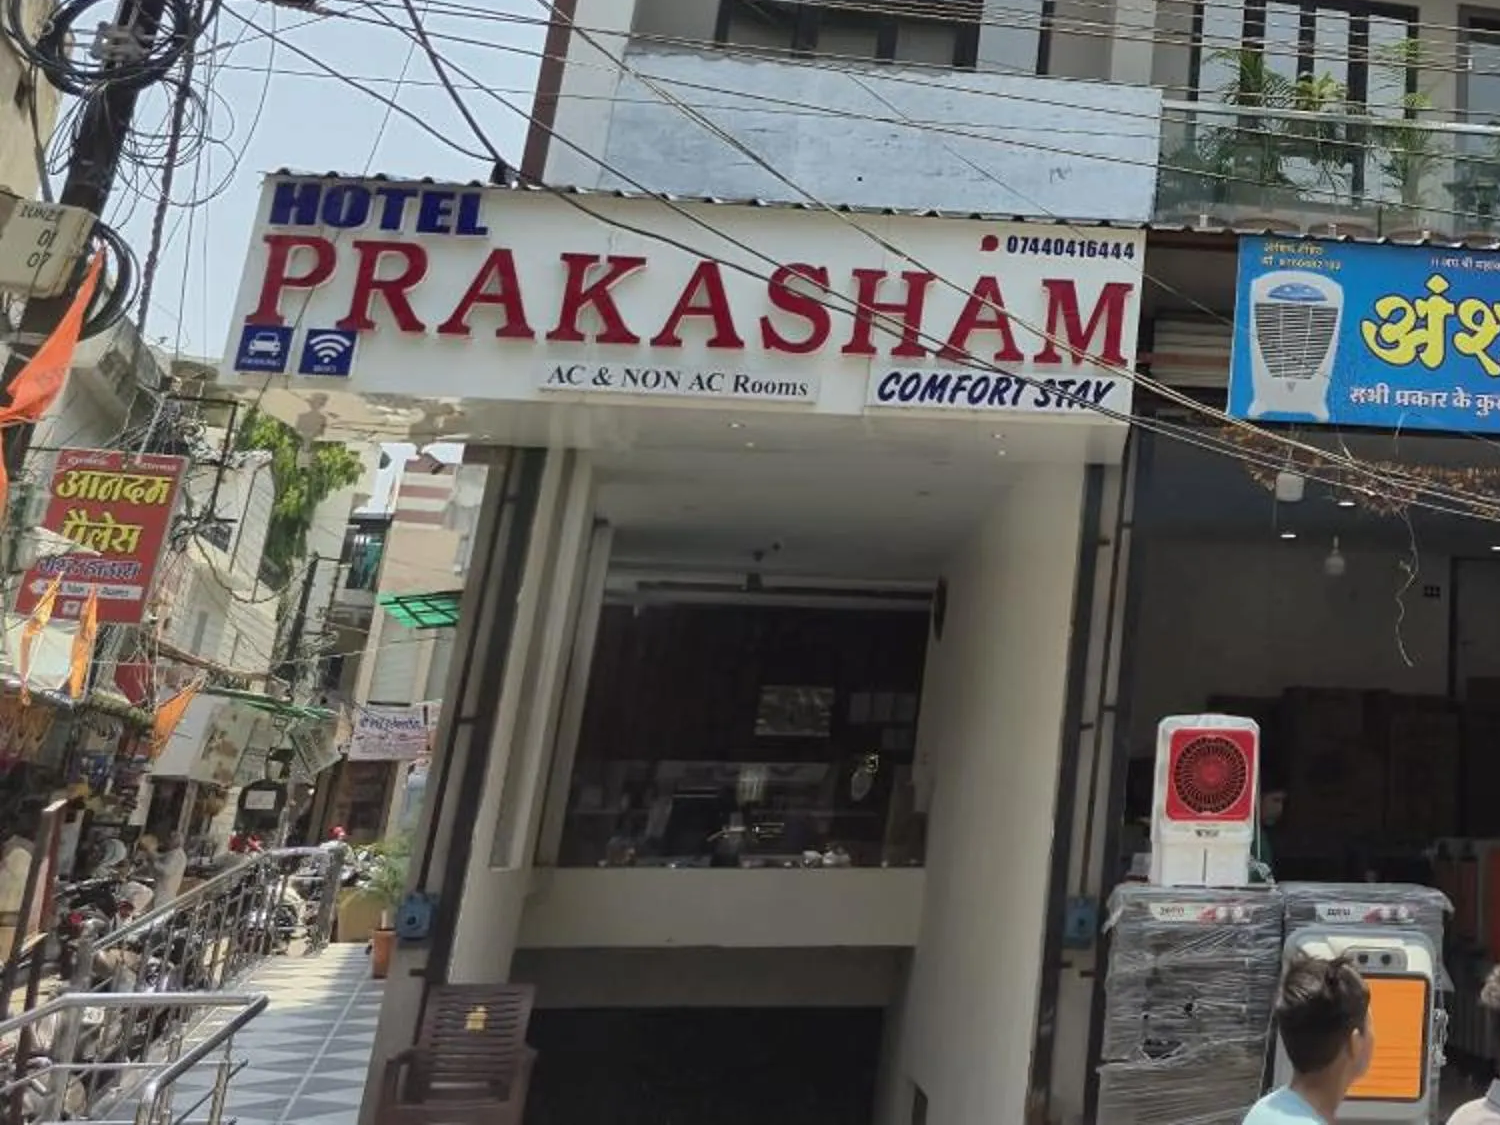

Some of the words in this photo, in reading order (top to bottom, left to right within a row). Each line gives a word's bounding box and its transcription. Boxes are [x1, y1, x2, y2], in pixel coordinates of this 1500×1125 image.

[269, 182, 488, 236] HOTEL
[1006, 235, 1135, 259] 07440416444
[245, 233, 1135, 368] PRAKASHAM
[548, 364, 586, 384] AC
[592, 366, 612, 386] &
[621, 368, 681, 389] NON
[688, 372, 724, 392] AC
[733, 374, 809, 396] Rooms
[877, 371, 1029, 406] COMFORT
[1033, 378, 1116, 408] STAY
[1349, 383, 1390, 404] सभी
[1394, 391, 1448, 407] प्रकार
[1450, 387, 1471, 408] के
